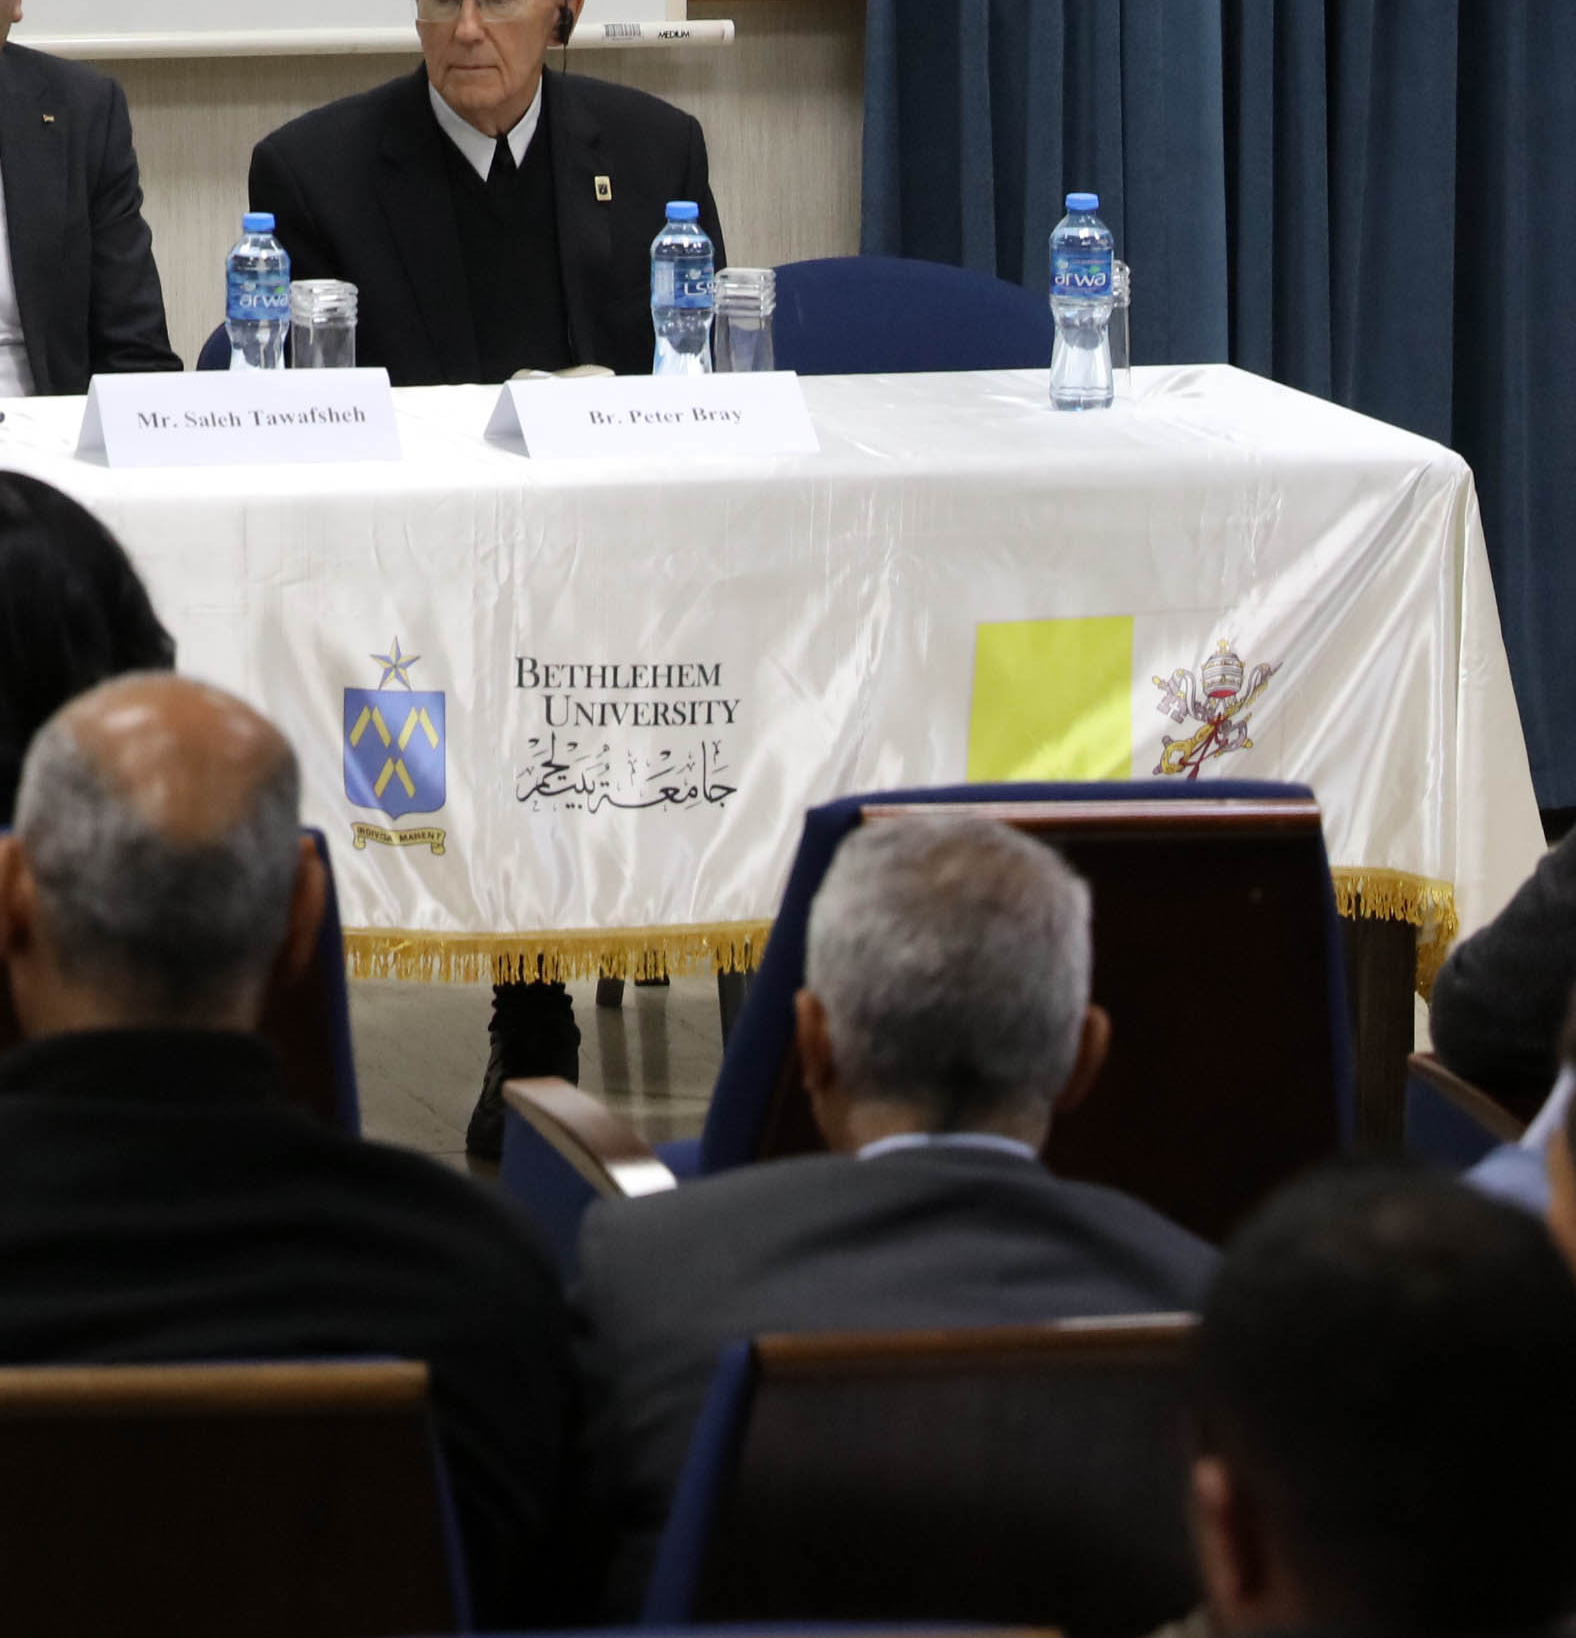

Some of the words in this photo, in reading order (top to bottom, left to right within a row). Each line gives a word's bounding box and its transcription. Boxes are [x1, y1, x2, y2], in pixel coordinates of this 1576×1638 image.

[657, 30, 690, 40] MEDIUM
[1054, 272, 1106, 287] arwa
[137, 410, 179, 430] Mr.
[183, 411, 242, 428] Saleh
[247, 406, 367, 428] Tawafsheh
[589, 409, 624, 427] Br.
[628, 409, 681, 424] Peter
[691, 405, 744, 428] Bray
[515, 657, 721, 689] BETHLEHEM
[543, 694, 740, 727] UNIVERSITY
